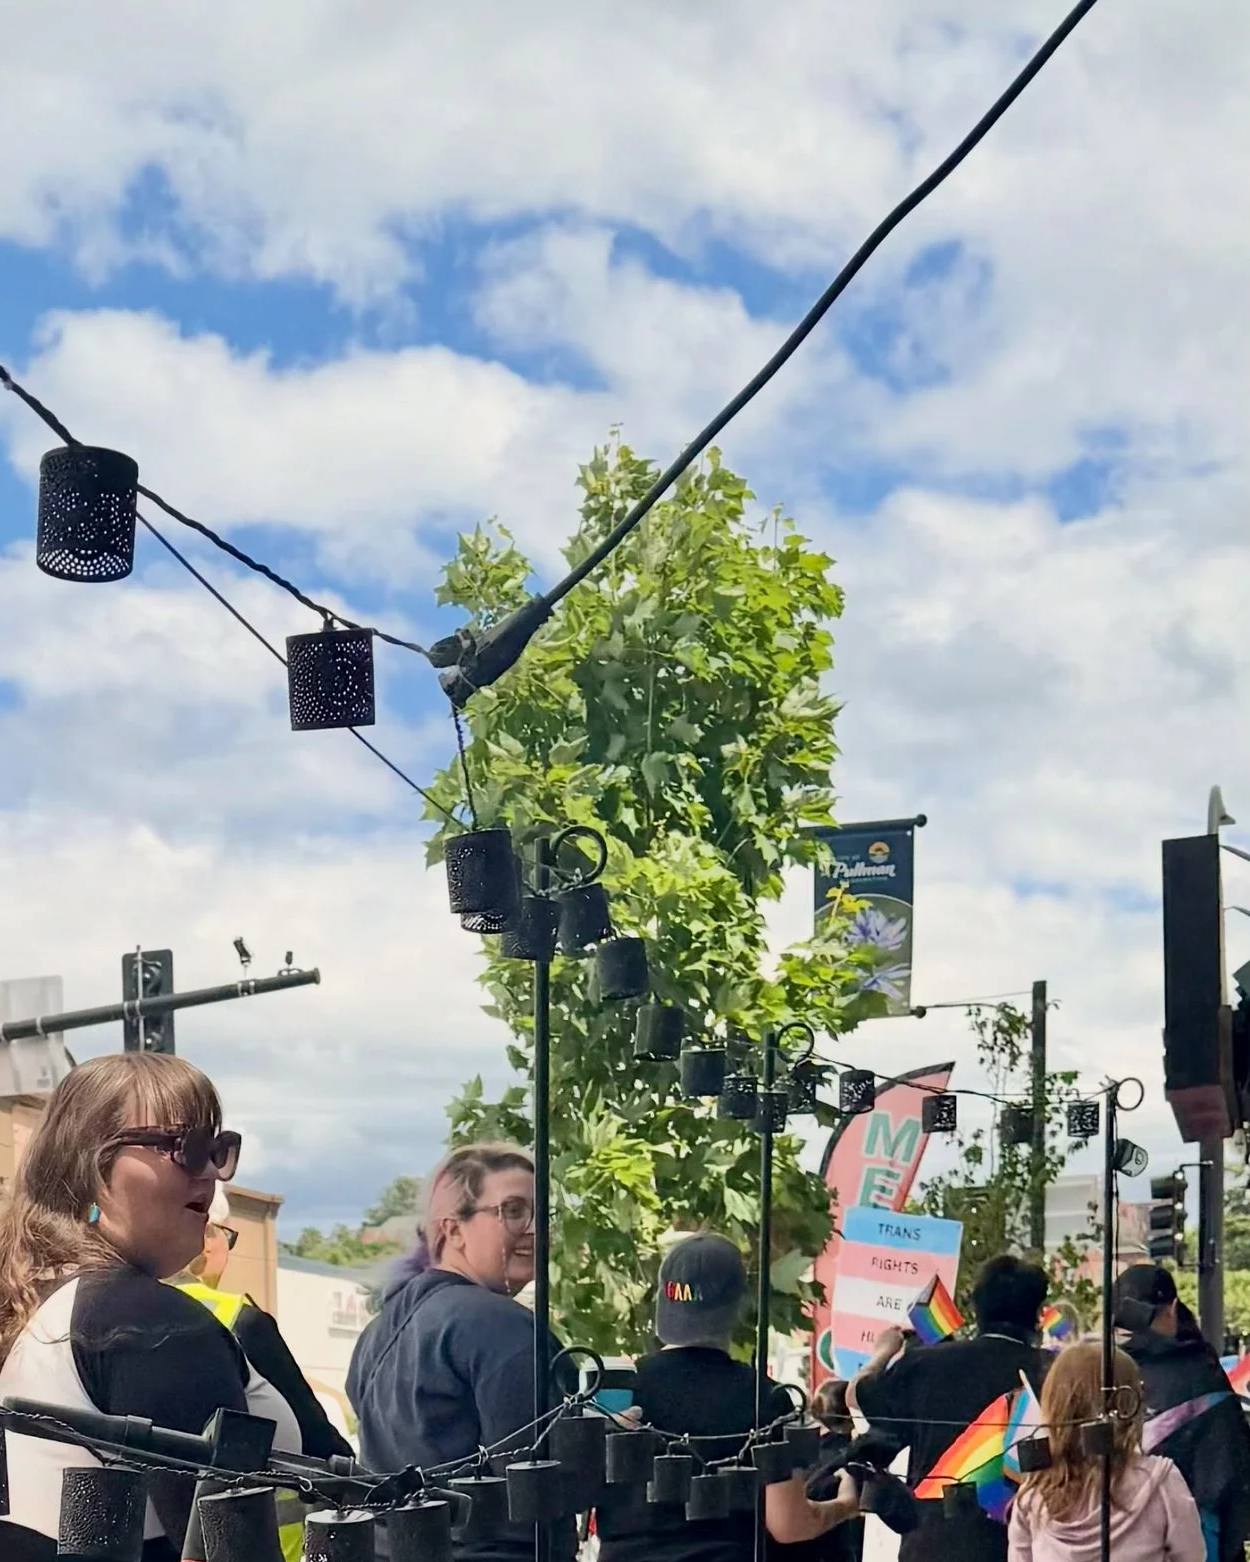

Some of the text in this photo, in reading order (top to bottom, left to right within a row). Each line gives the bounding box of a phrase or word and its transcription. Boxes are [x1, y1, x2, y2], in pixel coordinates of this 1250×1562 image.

[833, 861, 896, 879] Pullman
[876, 1222, 922, 1241] TRANS
[871, 1256, 919, 1275] RIGHTS
[876, 1295, 902, 1311] ARE
